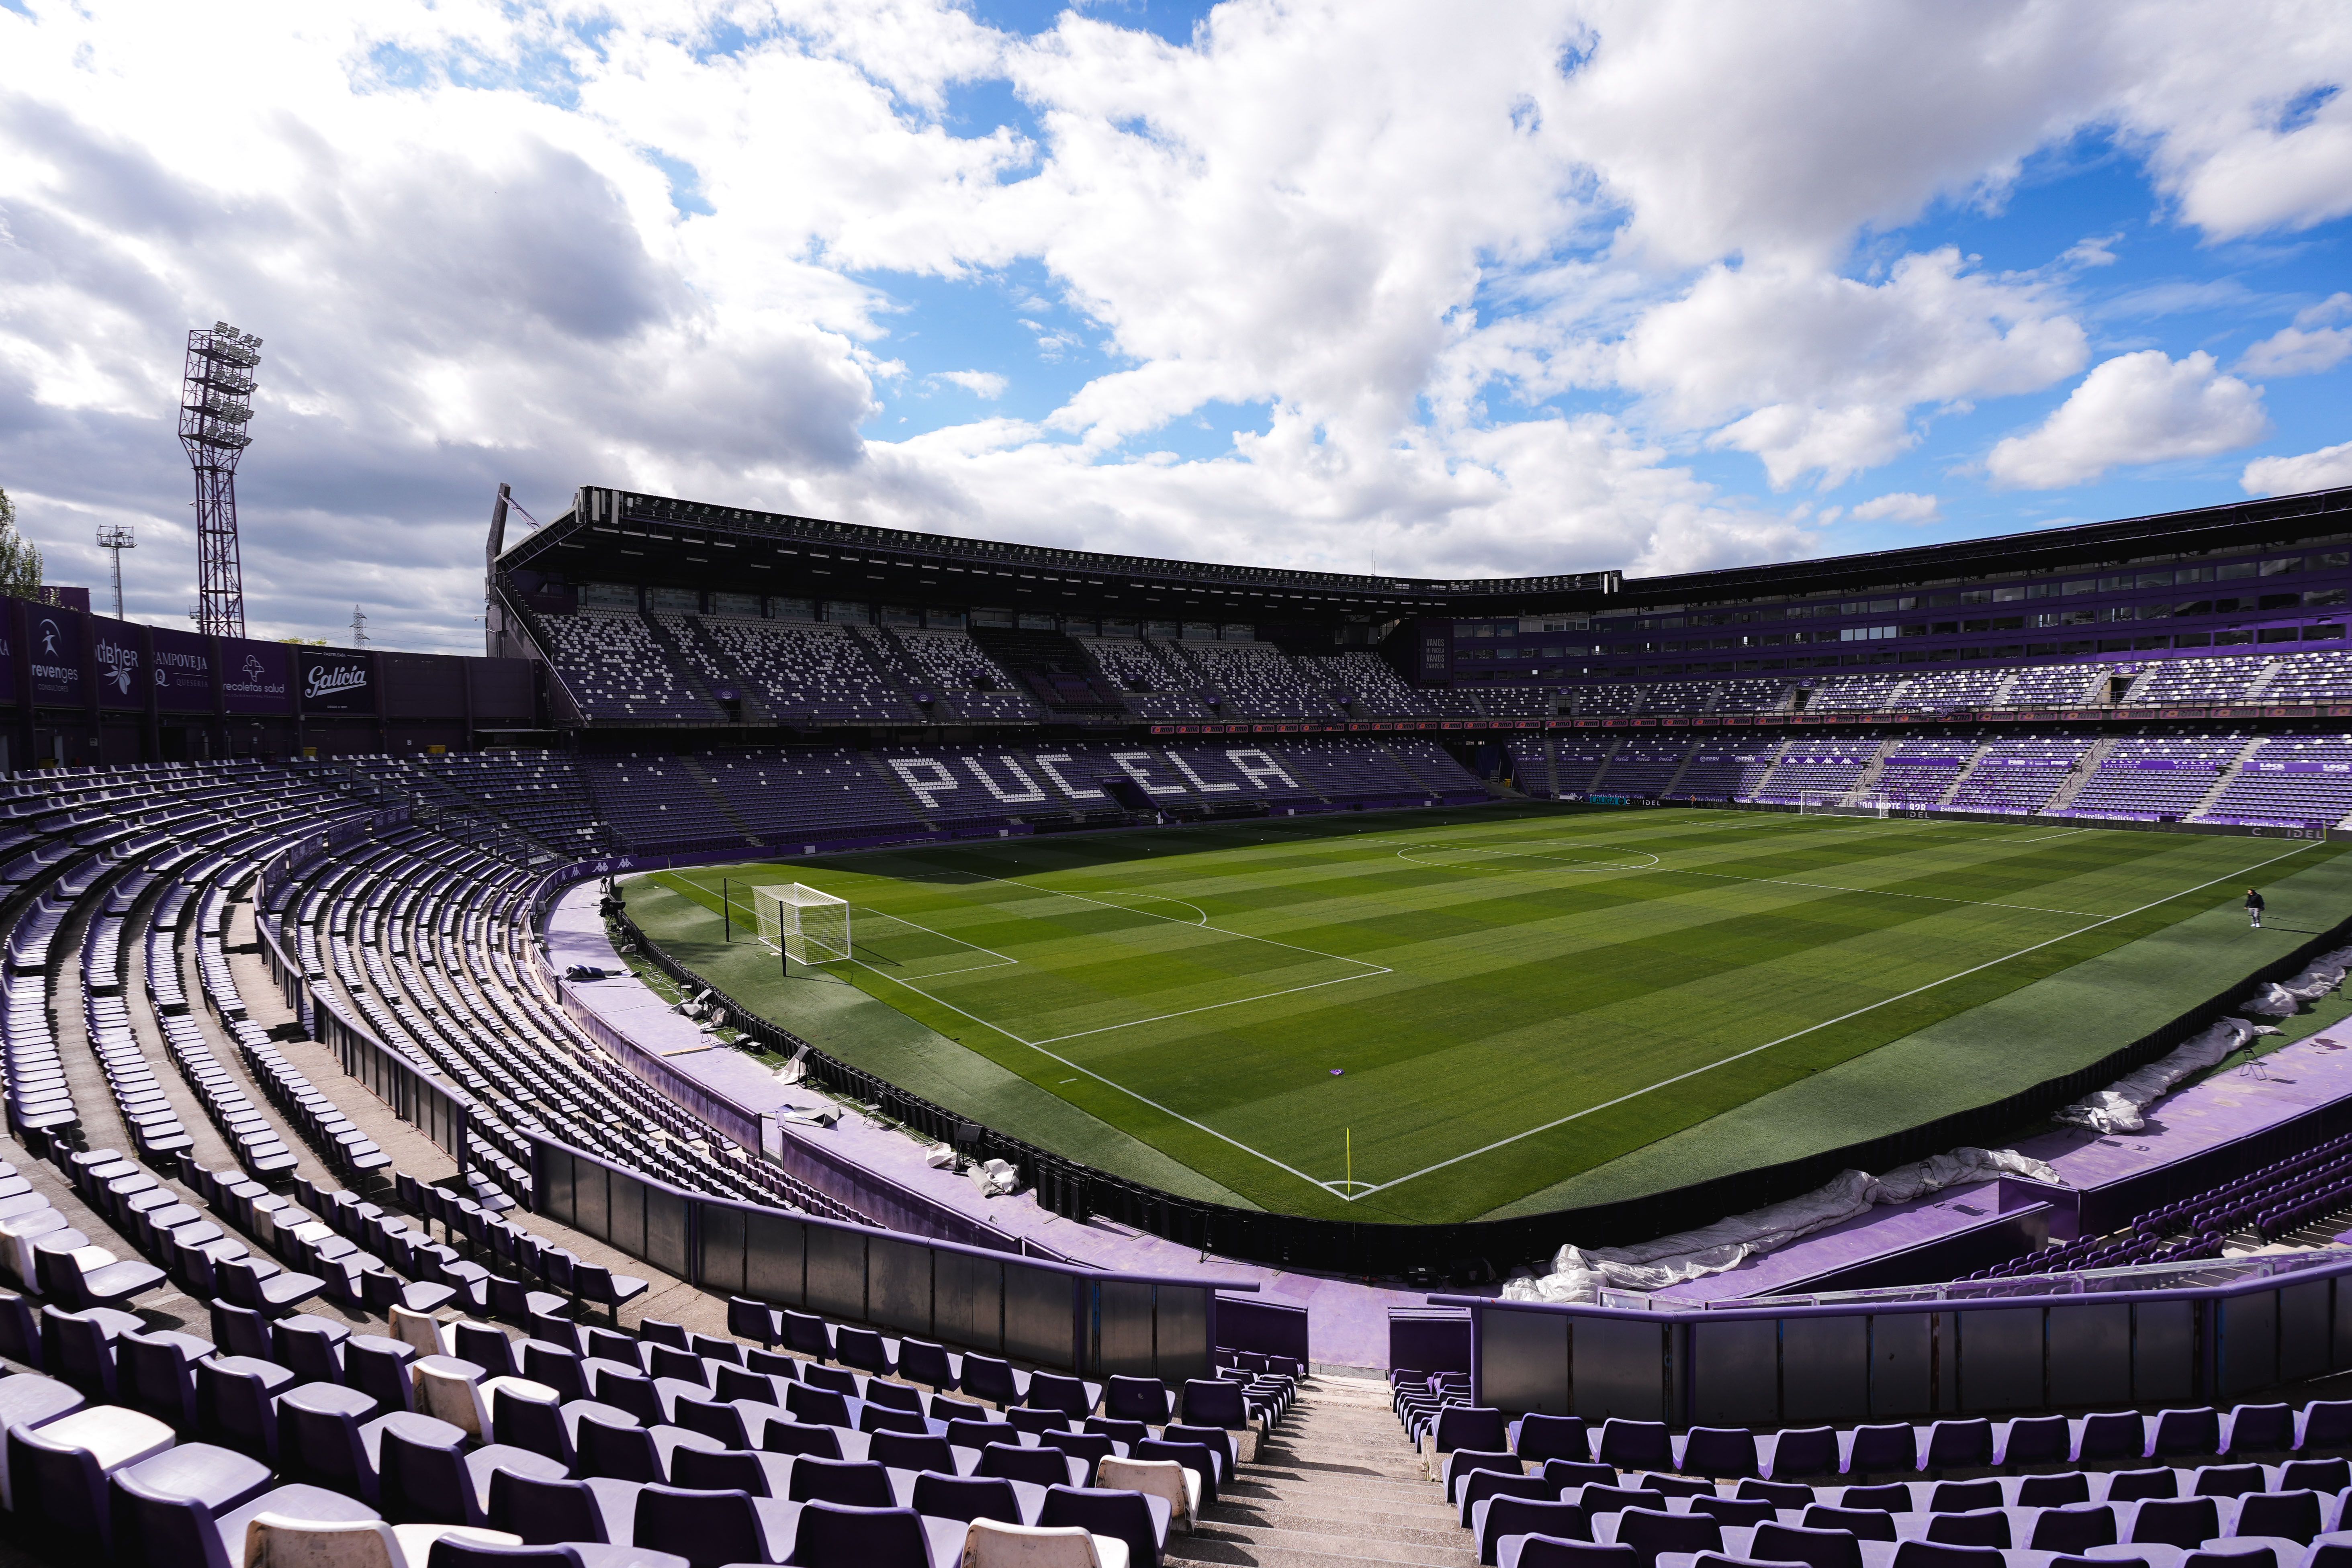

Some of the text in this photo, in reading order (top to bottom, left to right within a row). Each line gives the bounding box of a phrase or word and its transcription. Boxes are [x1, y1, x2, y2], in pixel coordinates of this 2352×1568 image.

[1426, 638, 1444, 646] VAMOS
[153, 652, 208, 671] AMPOVEJA
[1426, 654, 1444, 662] VAMOS
[31, 664, 78, 683] revenges
[38, 684, 69, 692] CONSULTORES
[223, 681, 285, 693] recoletas salud
[888, 749, 1299, 808] PUCELA
[2018, 817, 2064, 825] COSAS
[2071, 819, 2105, 827] BIEN
[2115, 821, 2177, 831] HECHAS
[2252, 828, 2323, 839] CAVIDEL
